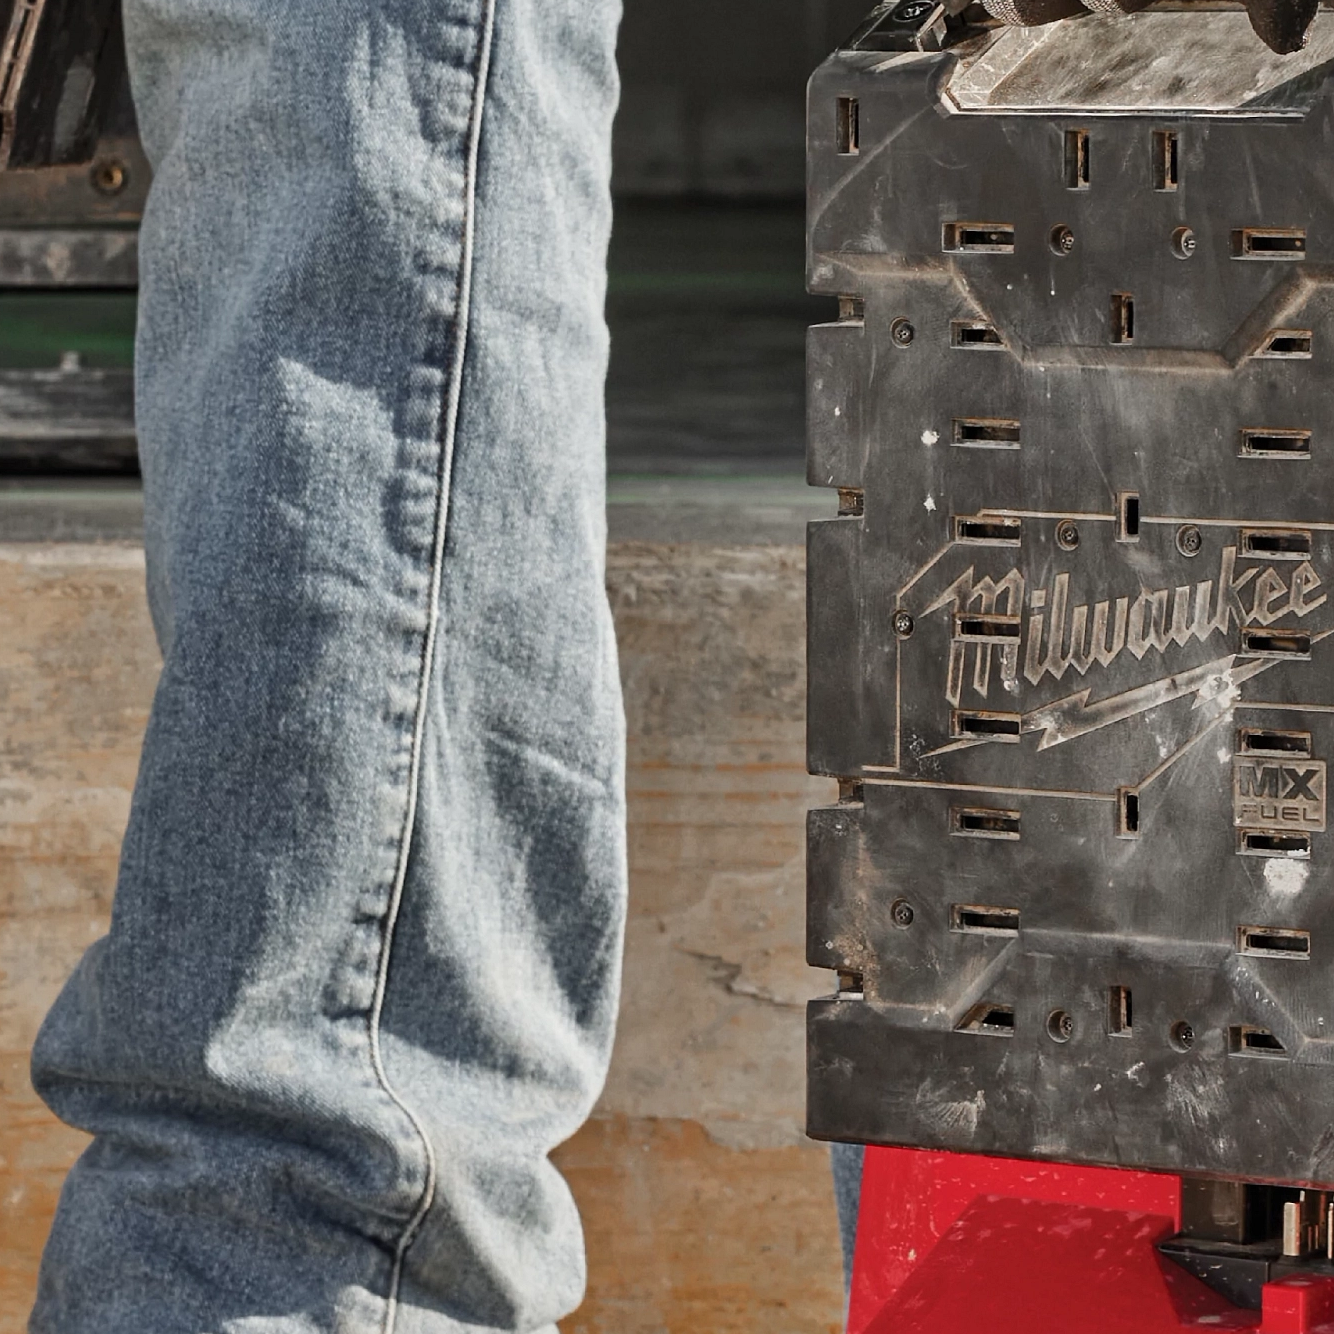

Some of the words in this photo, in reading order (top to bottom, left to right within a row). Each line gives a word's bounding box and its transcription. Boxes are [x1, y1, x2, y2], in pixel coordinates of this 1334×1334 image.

[919, 545, 1327, 708] Milwaukee
[1239, 765, 1320, 801] MX
[1240, 803, 1320, 822] FUEL
